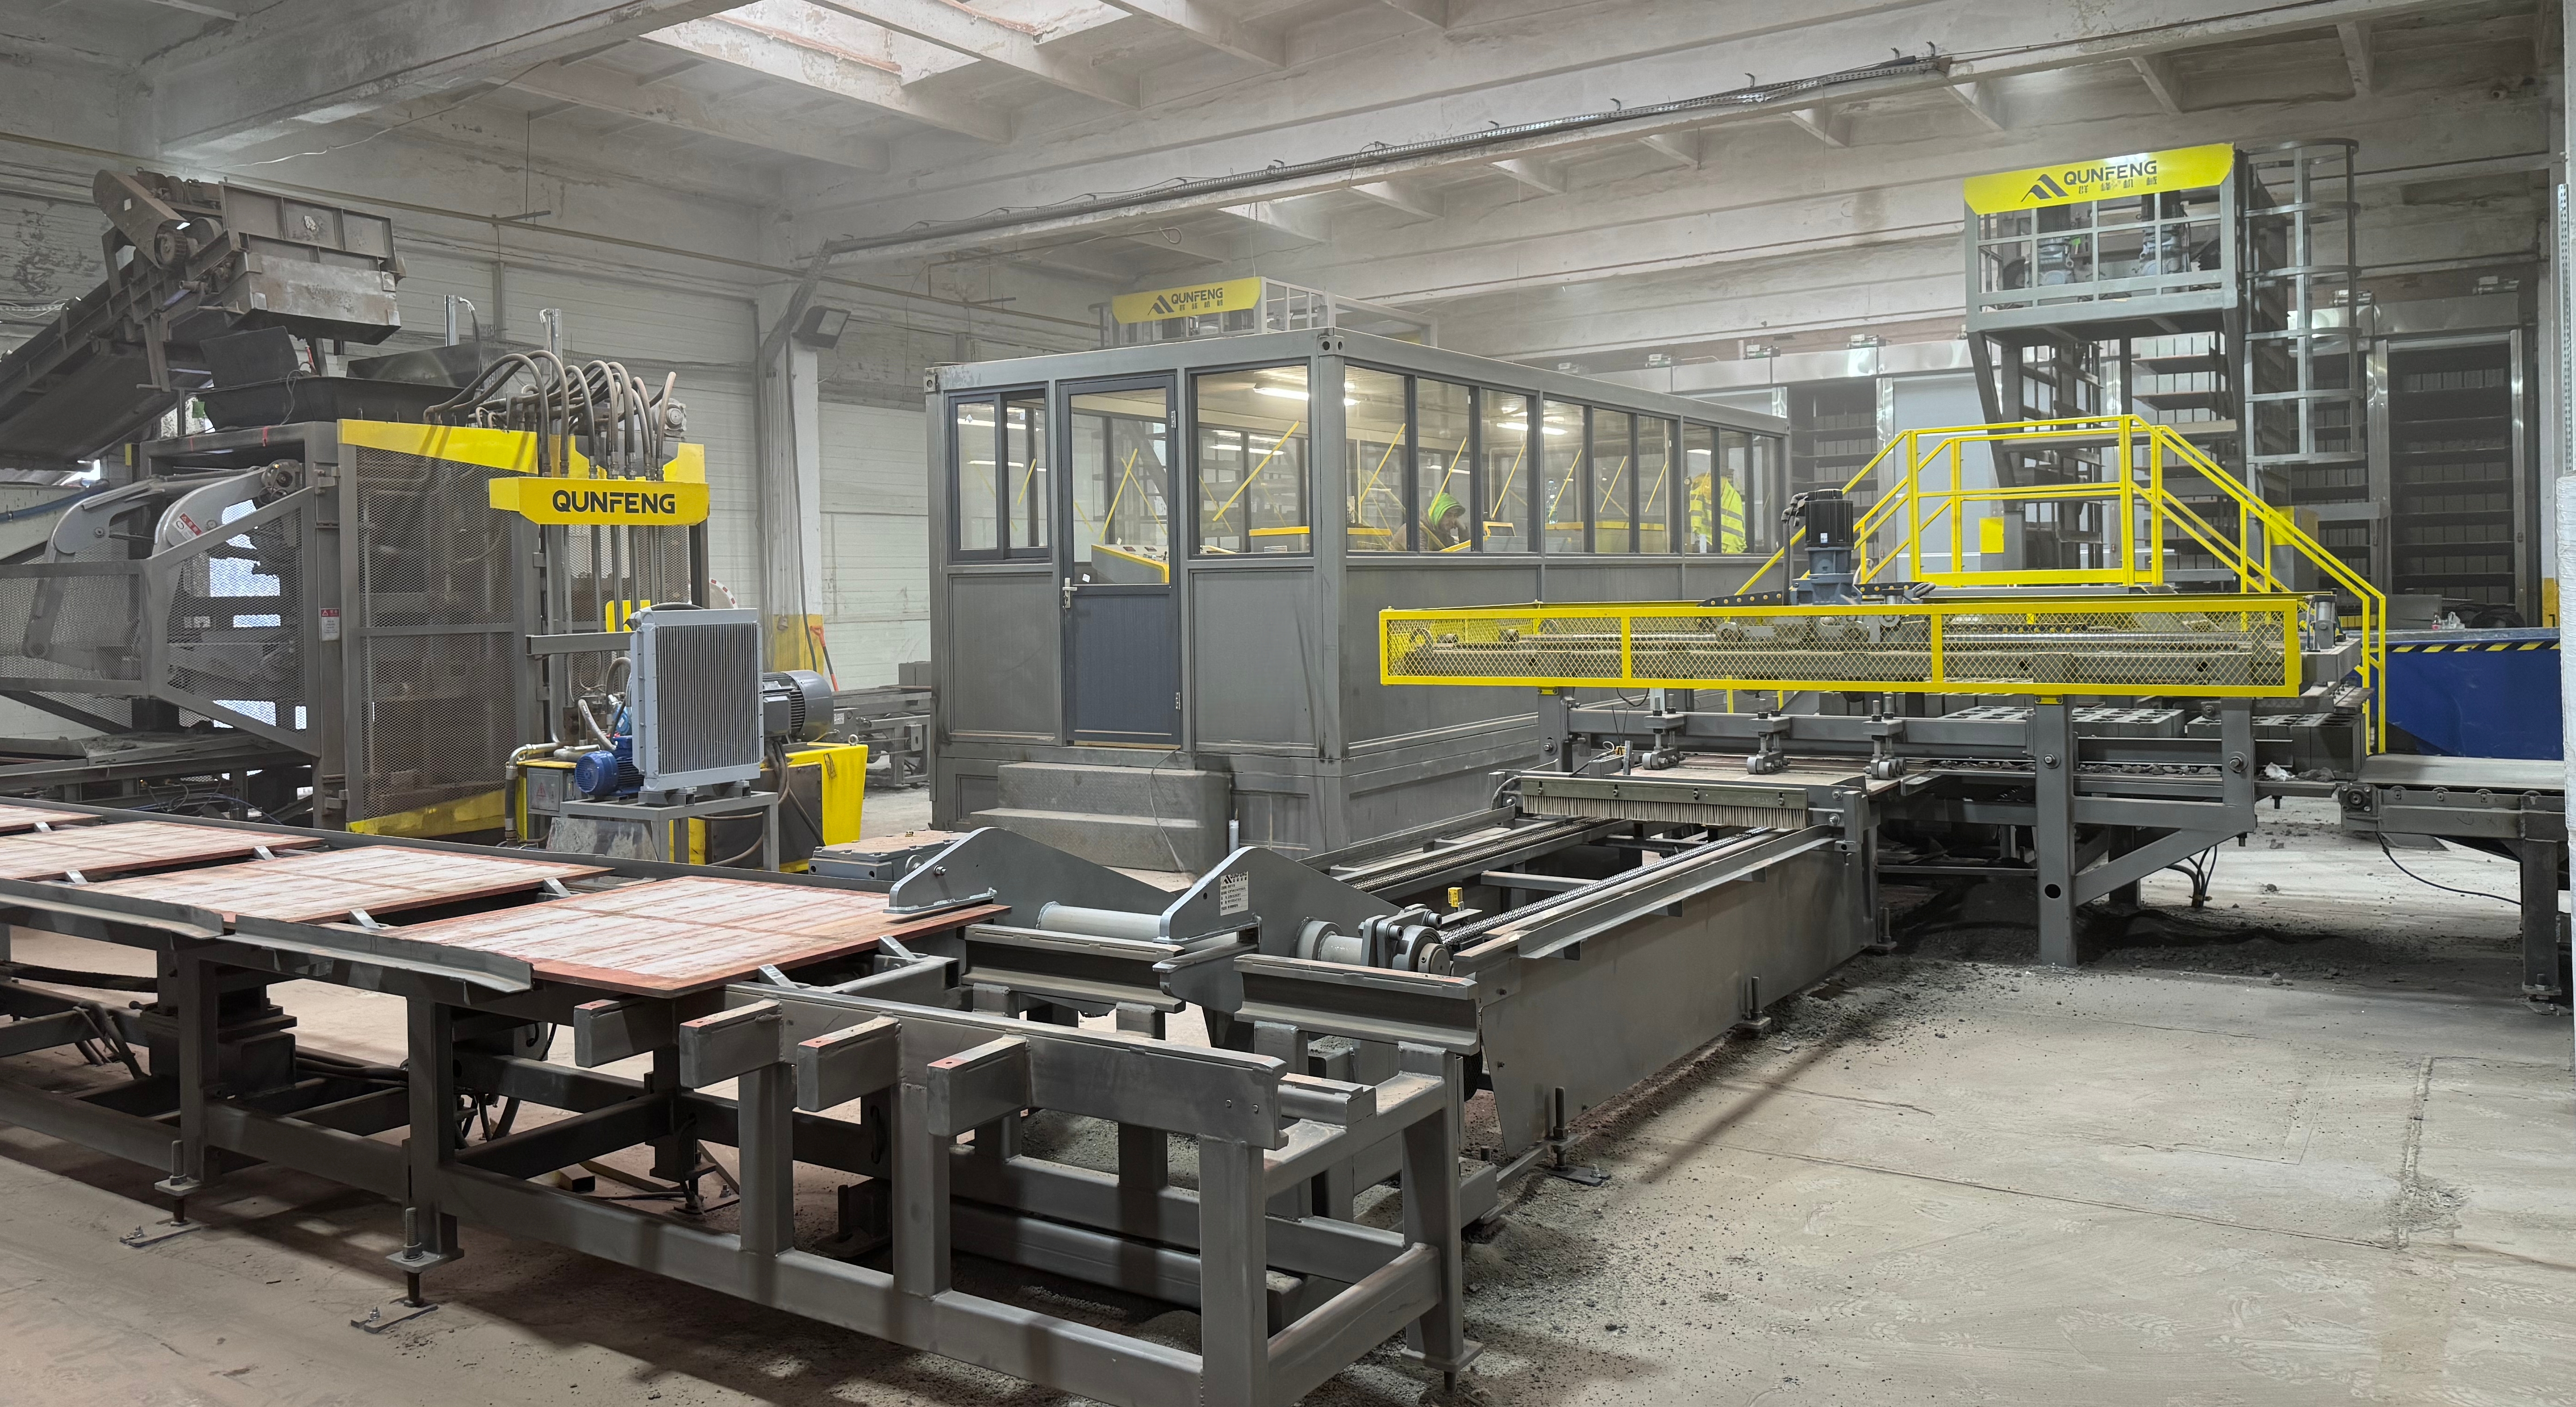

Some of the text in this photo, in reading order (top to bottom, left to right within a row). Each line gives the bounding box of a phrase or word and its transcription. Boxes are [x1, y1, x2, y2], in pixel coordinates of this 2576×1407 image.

[2064, 160, 2157, 185] QUNFENG
[1171, 287, 1223, 304] QUNFENG
[552, 490, 675, 514] QUNFENG
